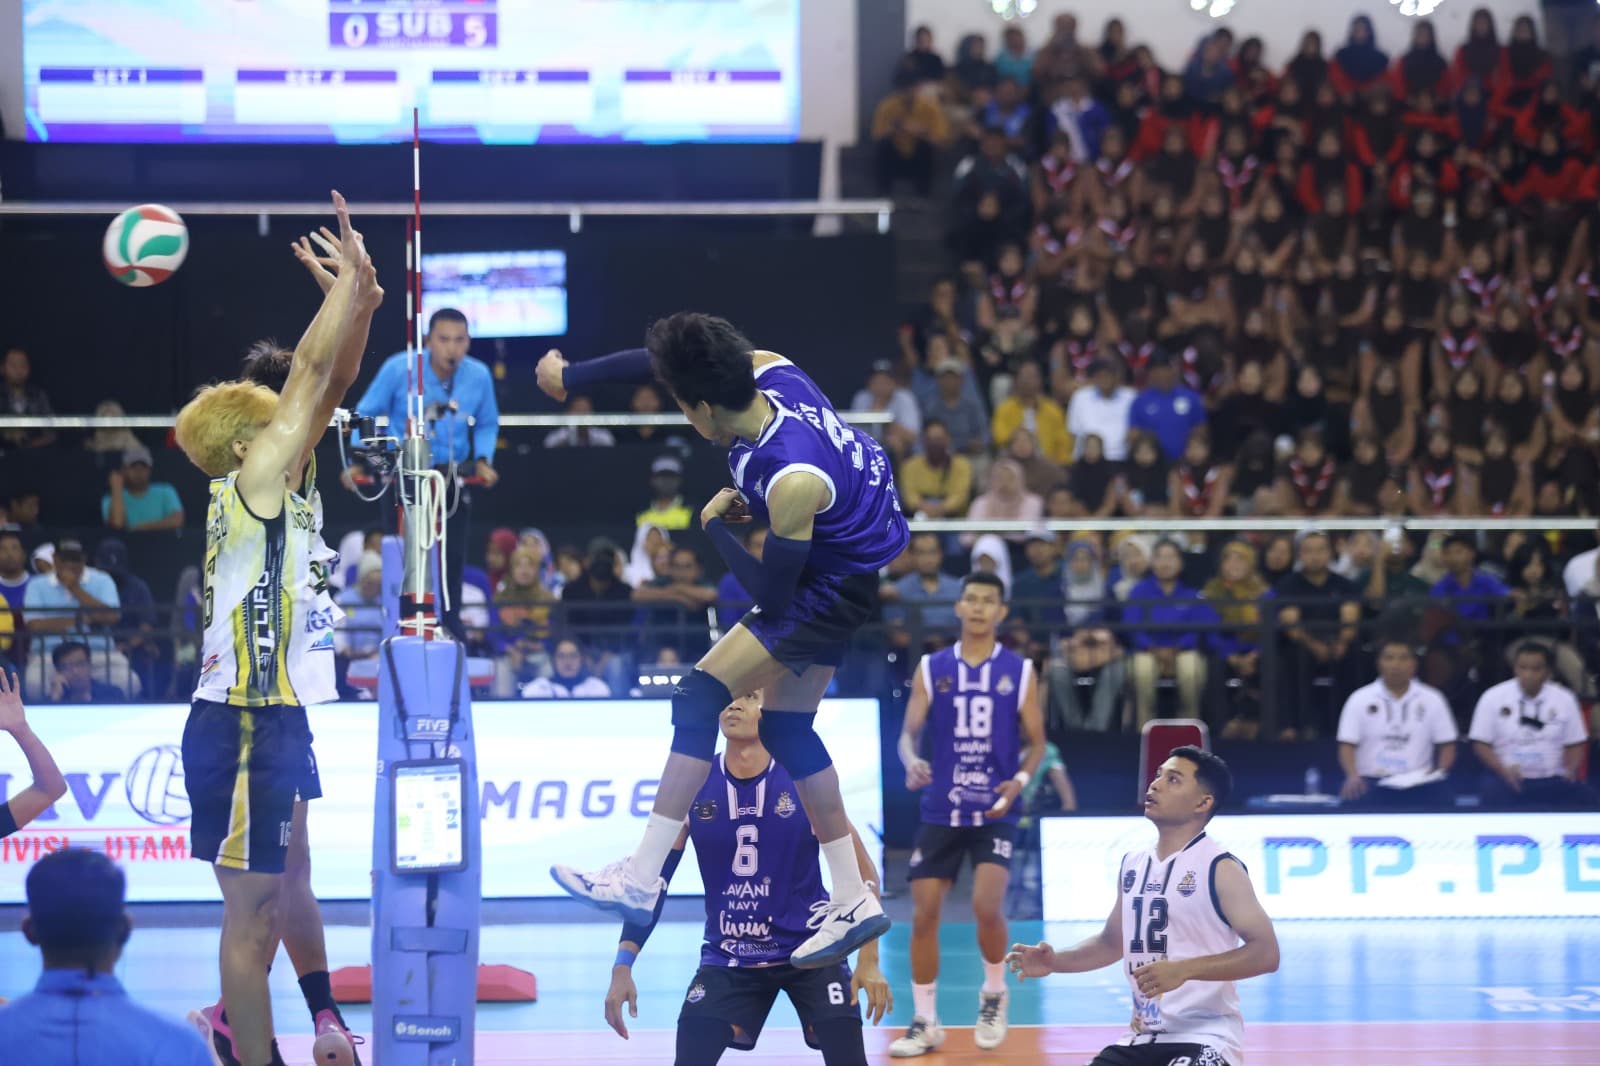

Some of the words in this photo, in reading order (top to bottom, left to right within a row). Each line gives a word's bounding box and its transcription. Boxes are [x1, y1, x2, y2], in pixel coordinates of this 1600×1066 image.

[343, 14, 369, 48] 0
[376, 9, 452, 38] SUB
[463, 14, 488, 48] 5
[93, 69, 128, 83] SET
[953, 696, 994, 737] 18
[105, 835, 195, 862] UTAM
[732, 824, 758, 877] 6
[992, 838, 1012, 859] 18
[728, 900, 759, 911] NAVY
[1130, 896, 1168, 953] 12
[827, 982, 844, 1005] 6
